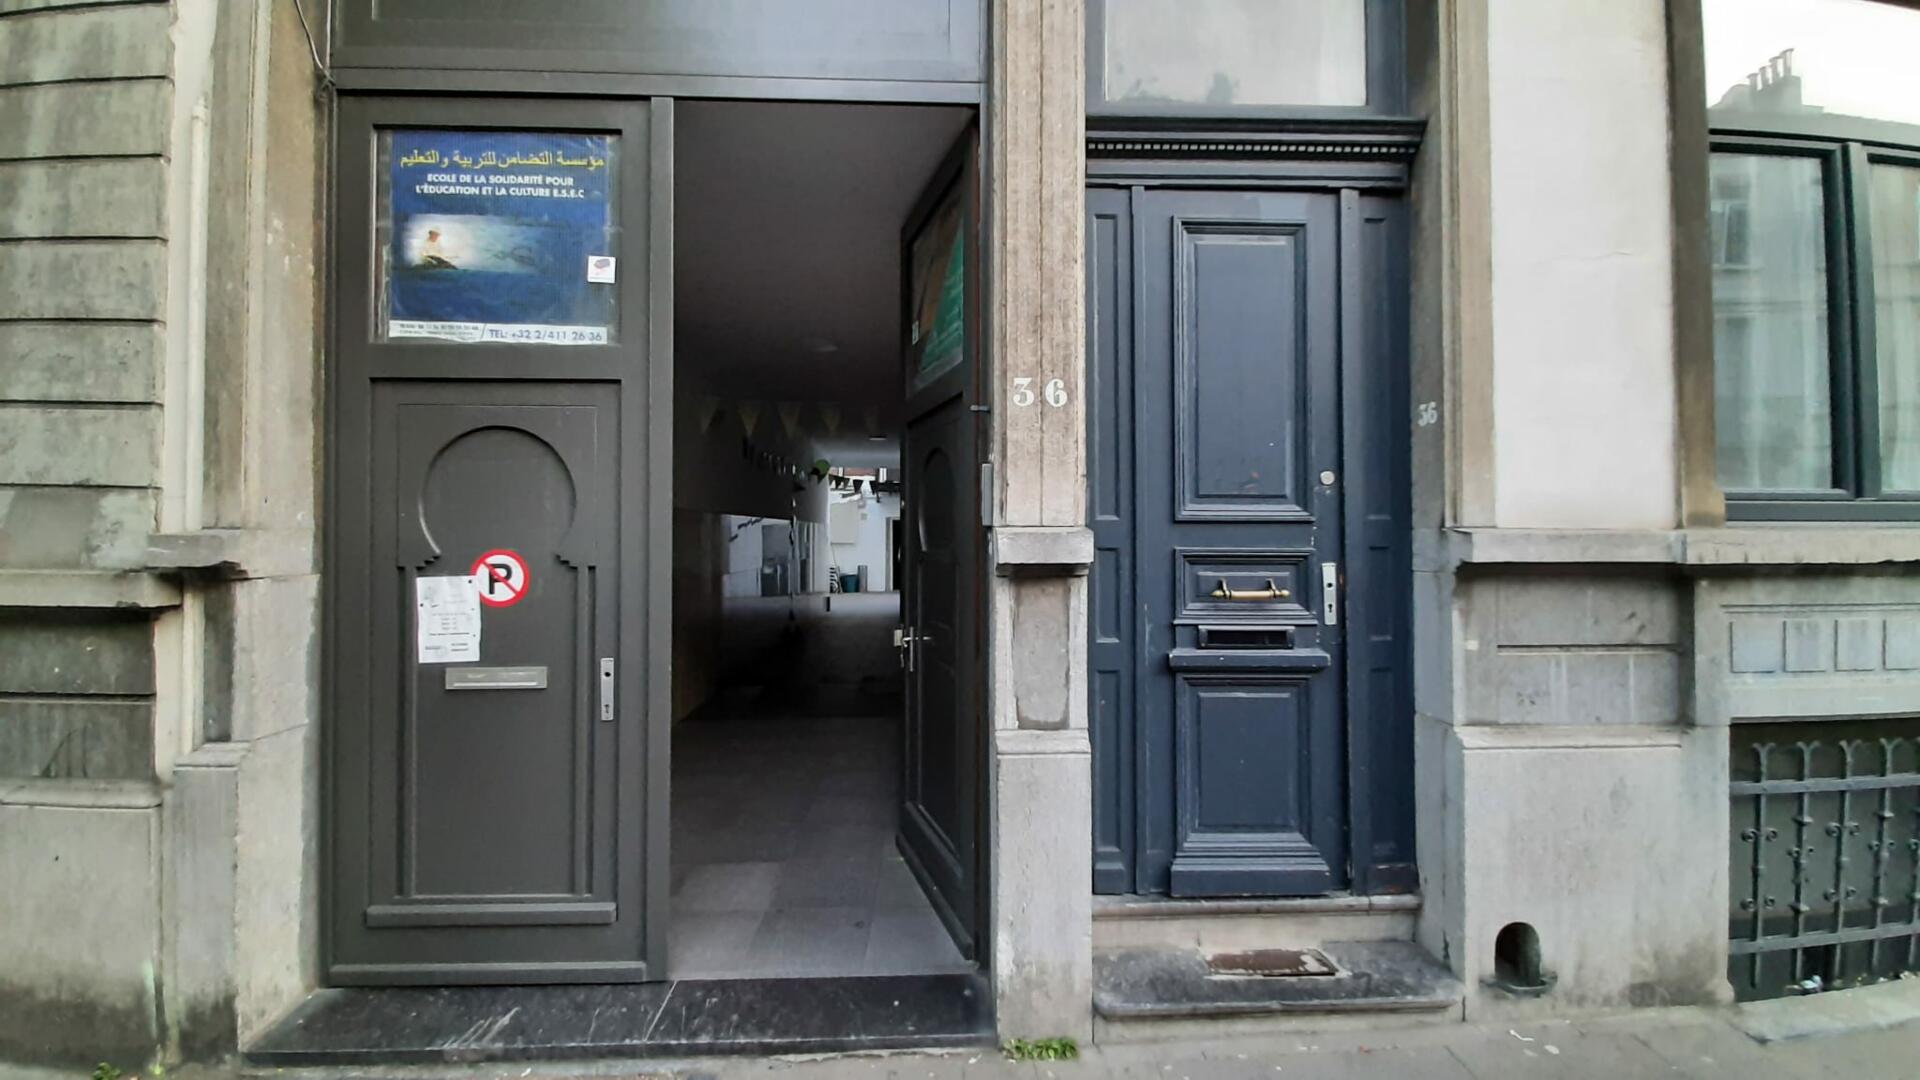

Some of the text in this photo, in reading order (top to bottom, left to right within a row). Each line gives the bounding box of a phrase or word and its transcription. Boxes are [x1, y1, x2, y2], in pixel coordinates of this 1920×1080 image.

[400, 149, 439, 169] التعليم
[498, 150, 552, 169] التضامن
[556, 150, 605, 171] مؤسسة
[427, 174, 456, 182] ECOLE
[459, 174, 471, 183] DE
[474, 175, 487, 183] LA
[546, 176, 574, 186] POUR
[481, 186, 493, 195] ET
[495, 186, 508, 195] LA
[509, 187, 550, 197] CULTURE
[572, 331, 586, 341] 26
[587, 332, 602, 341] 36
[1013, 377, 1067, 407] 36
[489, 563, 512, 595] P
